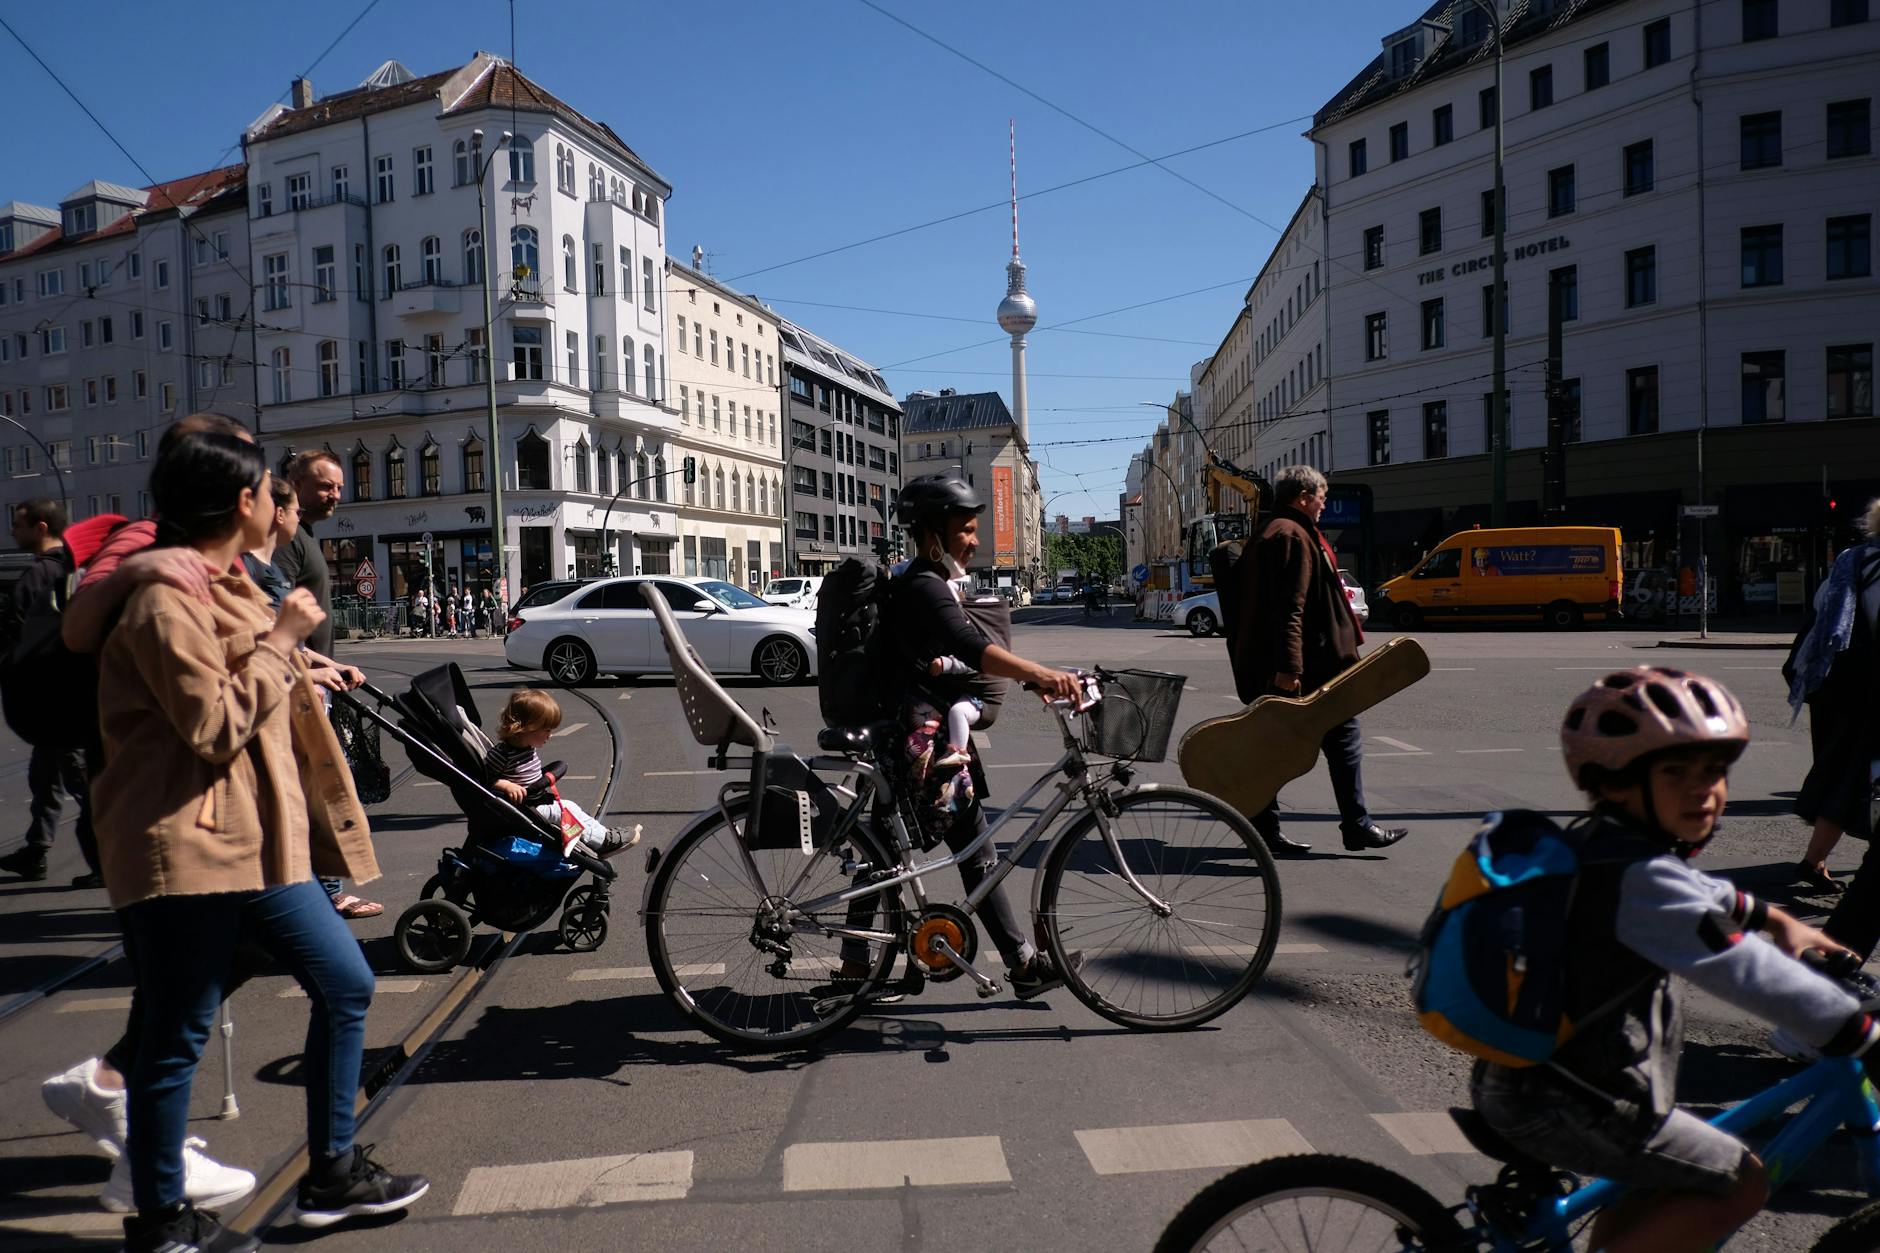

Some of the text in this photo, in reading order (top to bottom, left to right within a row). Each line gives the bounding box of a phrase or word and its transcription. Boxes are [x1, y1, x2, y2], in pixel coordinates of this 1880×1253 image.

[1417, 268, 1445, 285] THE
[1514, 236, 1570, 260] HOTEL
[1332, 499, 1342, 514] U
[1499, 549, 1537, 561] Watt?
[361, 584, 372, 592] 30
